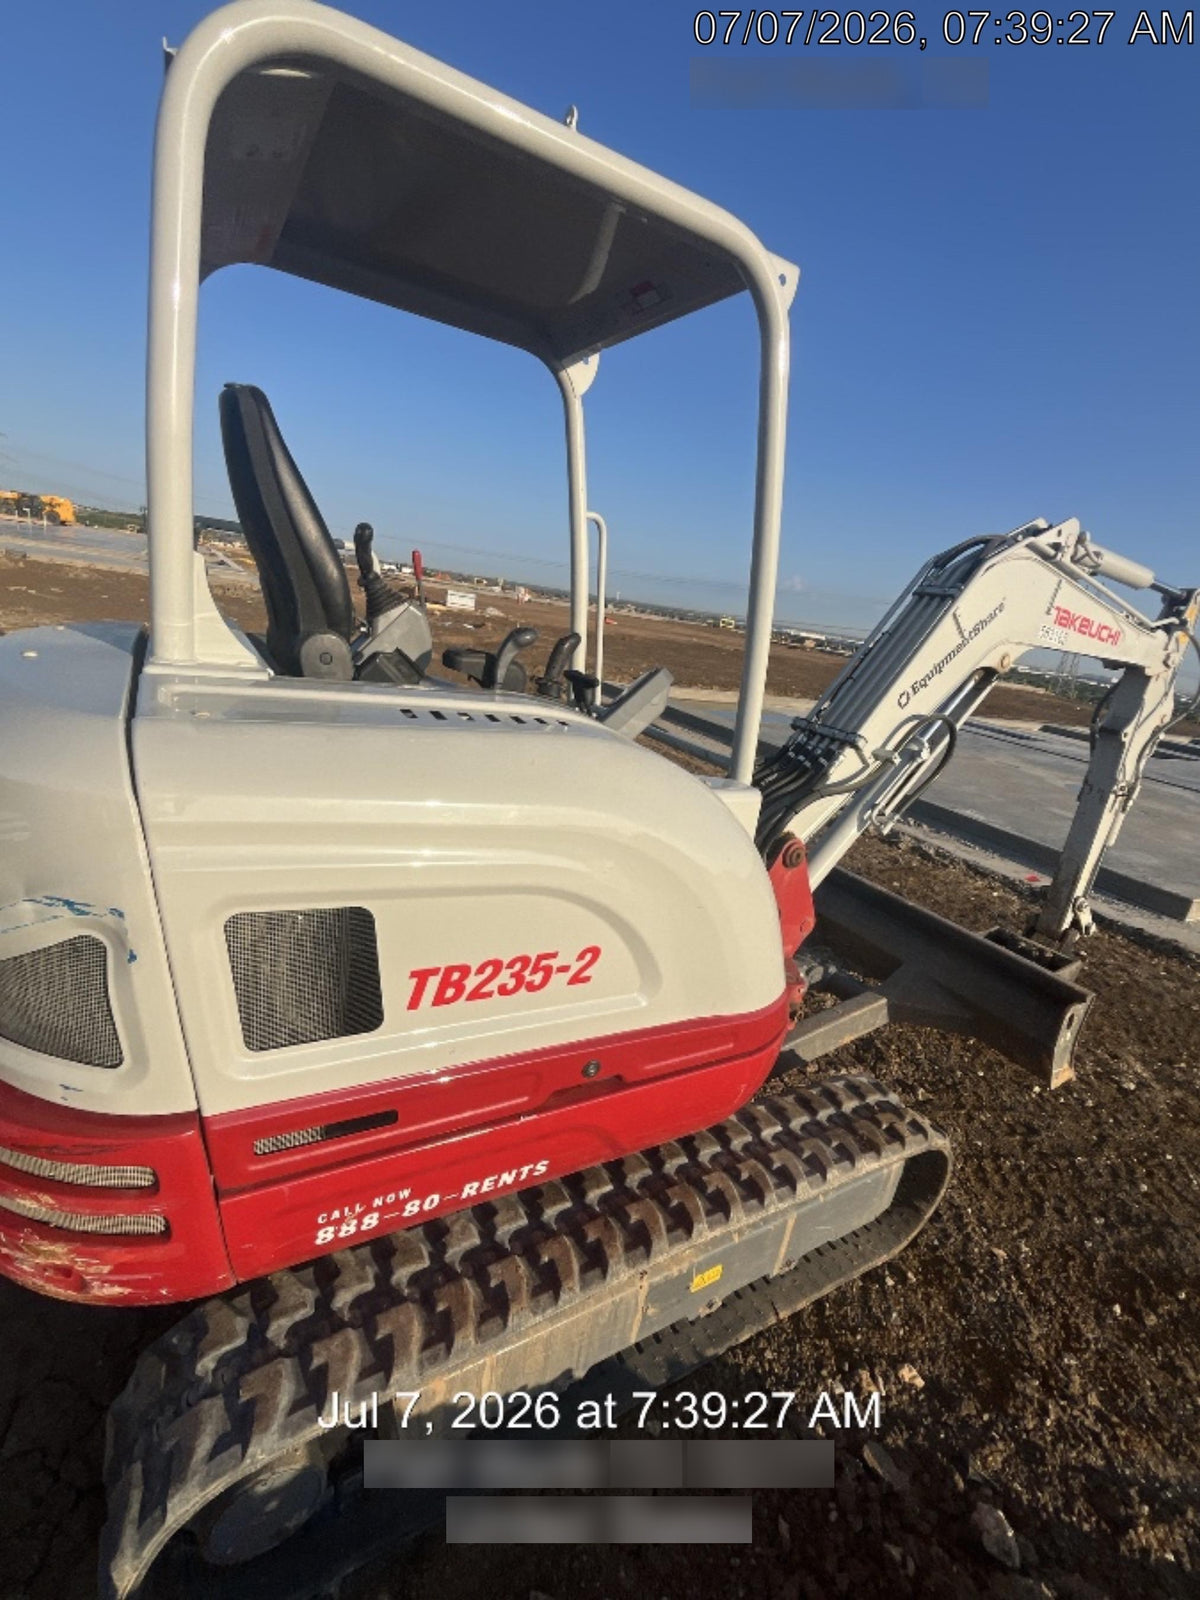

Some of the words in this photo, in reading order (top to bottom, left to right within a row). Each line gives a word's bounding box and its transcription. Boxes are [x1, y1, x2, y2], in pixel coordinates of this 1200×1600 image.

[911, 601, 1005, 697] EquipmentShare
[1053, 605, 1121, 646] TAKEUCHI
[406, 945, 601, 1011] TB235-2
[314, 1160, 550, 1246] 888-80-RENTS
[316, 1202, 366, 1225] CALL
[372, 1187, 412, 1208] NOW
